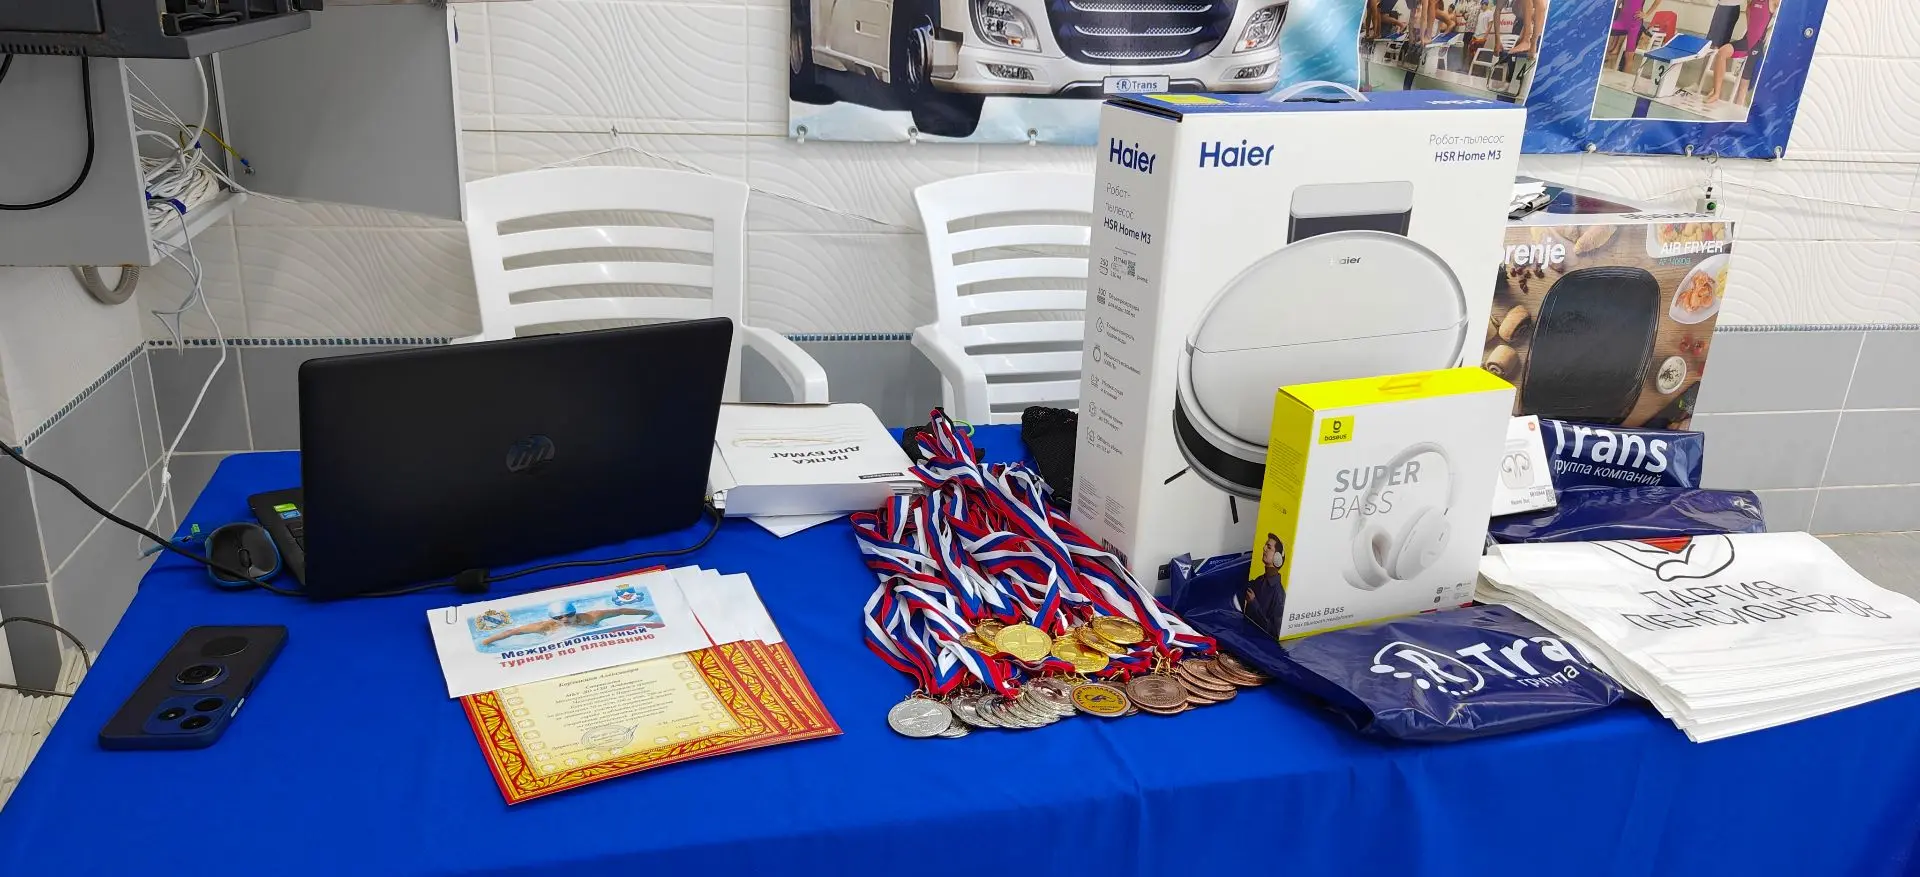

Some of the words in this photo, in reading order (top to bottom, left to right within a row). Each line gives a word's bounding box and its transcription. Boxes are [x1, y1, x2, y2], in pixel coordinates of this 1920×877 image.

[1132, 80, 1158, 90] Trans
[1654, 65, 1665, 86] 3
[1429, 133, 1505, 146] Робот-пылесос
[1108, 137, 1156, 175] Haier
[1199, 139, 1275, 168] Haier
[1434, 151, 1456, 162] HSR
[1457, 150, 1486, 162] Home
[1487, 149, 1502, 161] M3
[1103, 216, 1118, 232] HSR
[1118, 222, 1140, 240] Home
[1140, 230, 1152, 245] M3
[1503, 236, 1566, 270] renje
[1660, 242, 1682, 255] AIR
[1684, 240, 1724, 254] FRYER
[828, 445, 860, 453] ДЛЯ
[1324, 433, 1347, 442] baseus
[1552, 419, 1669, 473] Trans
[771, 450, 826, 459] БУМАГ
[792, 455, 849, 465] ПАПКА
[1333, 460, 1421, 493] SUPER
[1593, 466, 1662, 486] компаний
[1330, 490, 1394, 520] BASS
[1639, 580, 1798, 610] ПАРТИЯ
[1288, 609, 1321, 622] Baseus
[1323, 606, 1345, 616] Bass
[1621, 593, 1893, 631] ПЕНСИОНЕРОВ
[500, 652, 554, 668] турнир
[558, 647, 576, 658] по
[581, 633, 656, 652] плаванию
[501, 626, 648, 660] Межрегиональный
[1517, 665, 1580, 688] группа
